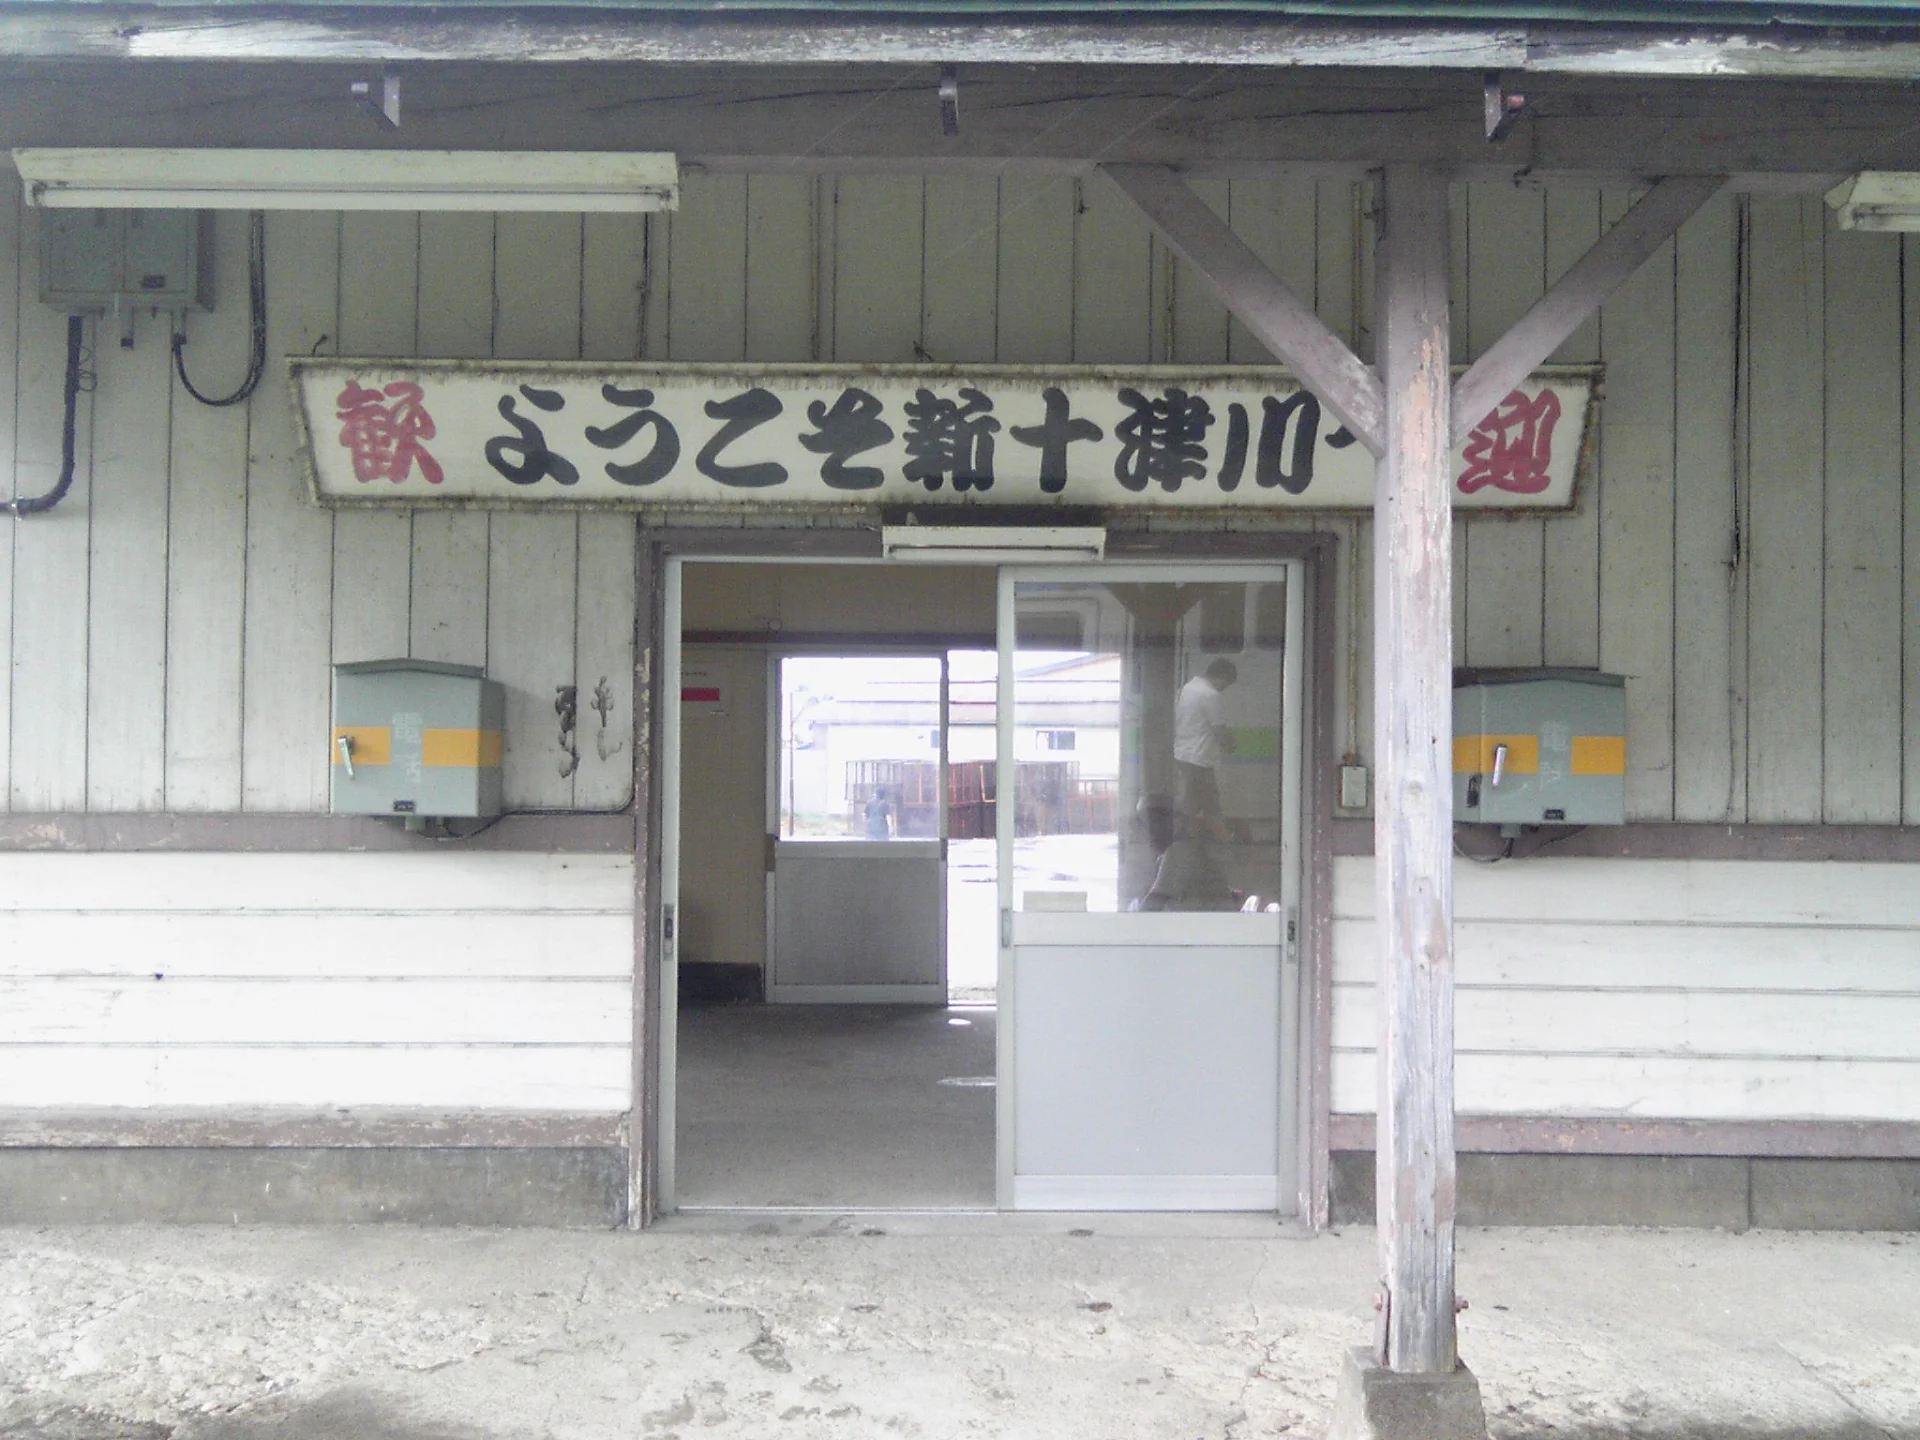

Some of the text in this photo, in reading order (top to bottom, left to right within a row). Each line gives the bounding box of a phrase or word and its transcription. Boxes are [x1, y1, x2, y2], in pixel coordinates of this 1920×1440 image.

[336, 379, 444, 485] 歓
[485, 383, 1356, 495] ようこそ新十津川
